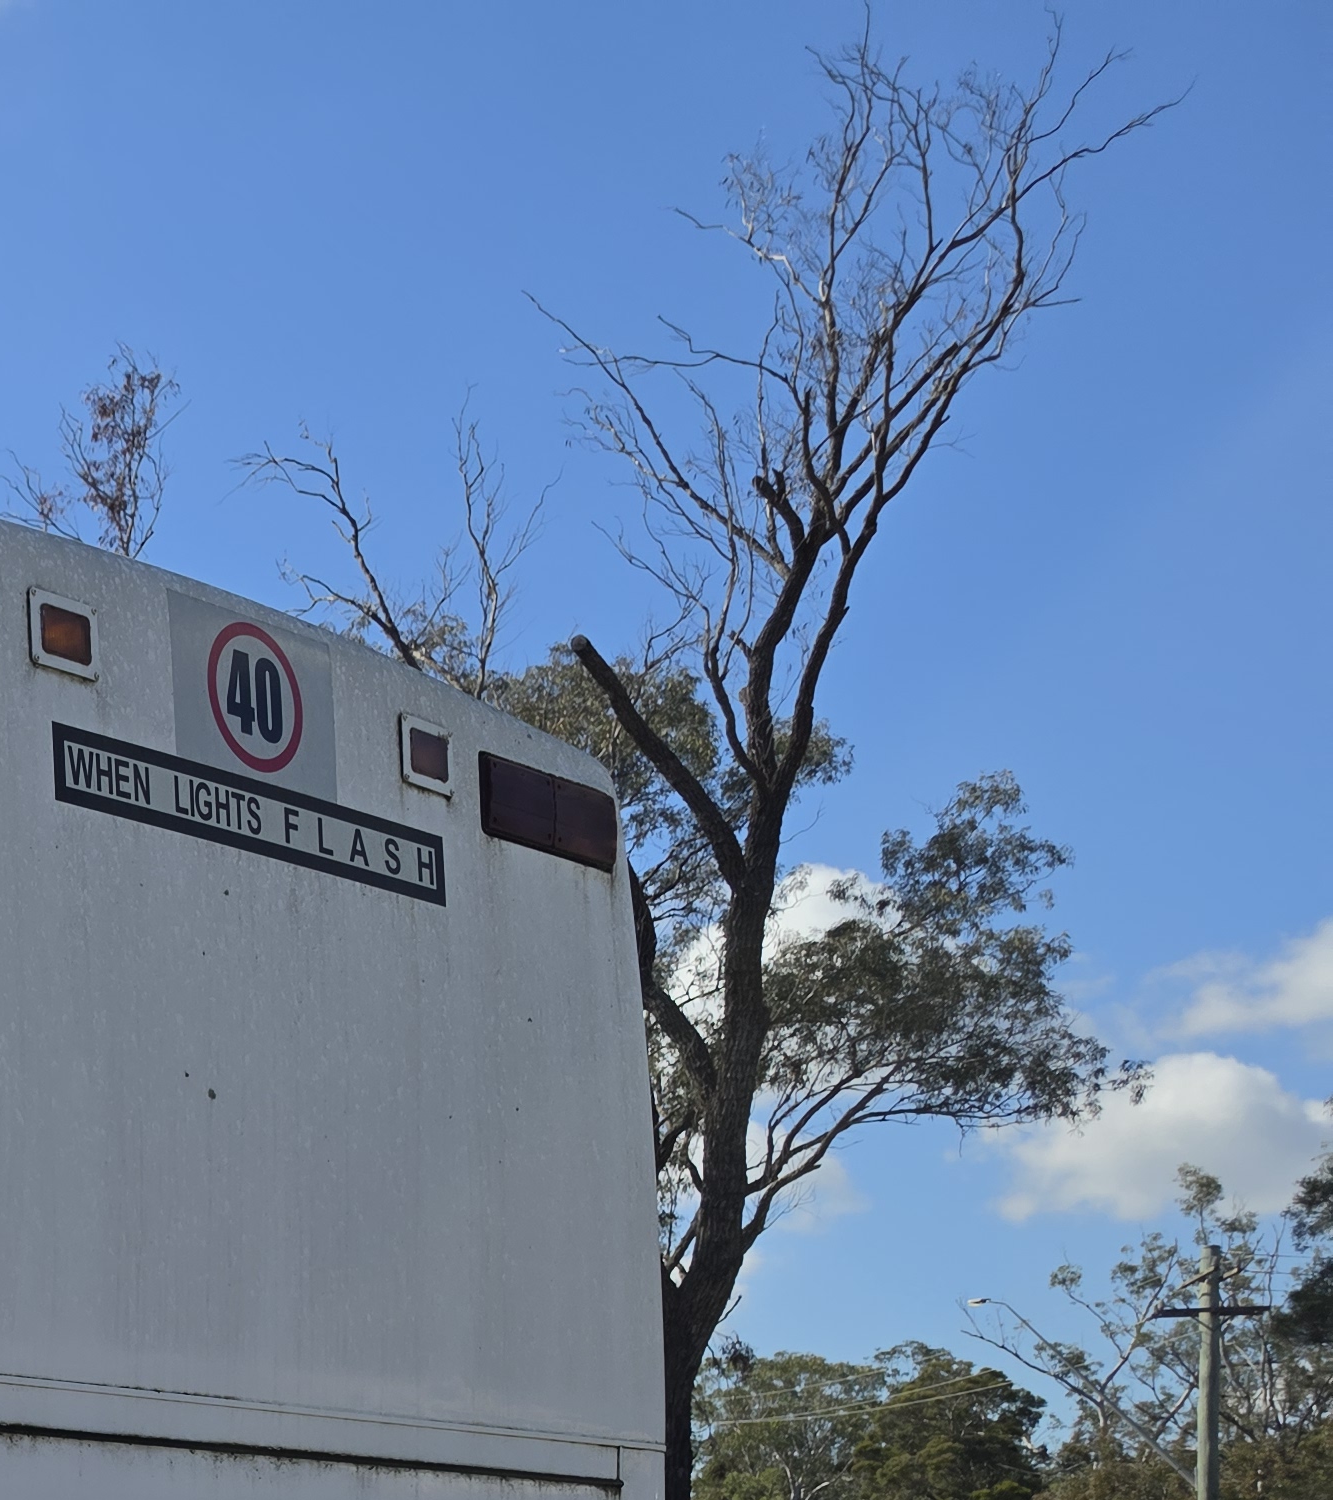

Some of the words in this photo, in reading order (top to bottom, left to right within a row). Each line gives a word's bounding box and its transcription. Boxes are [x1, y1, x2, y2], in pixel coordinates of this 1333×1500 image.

[226, 648, 284, 744] 40
[67, 745, 151, 806] WHEN
[173, 774, 262, 836] LIGHTS
